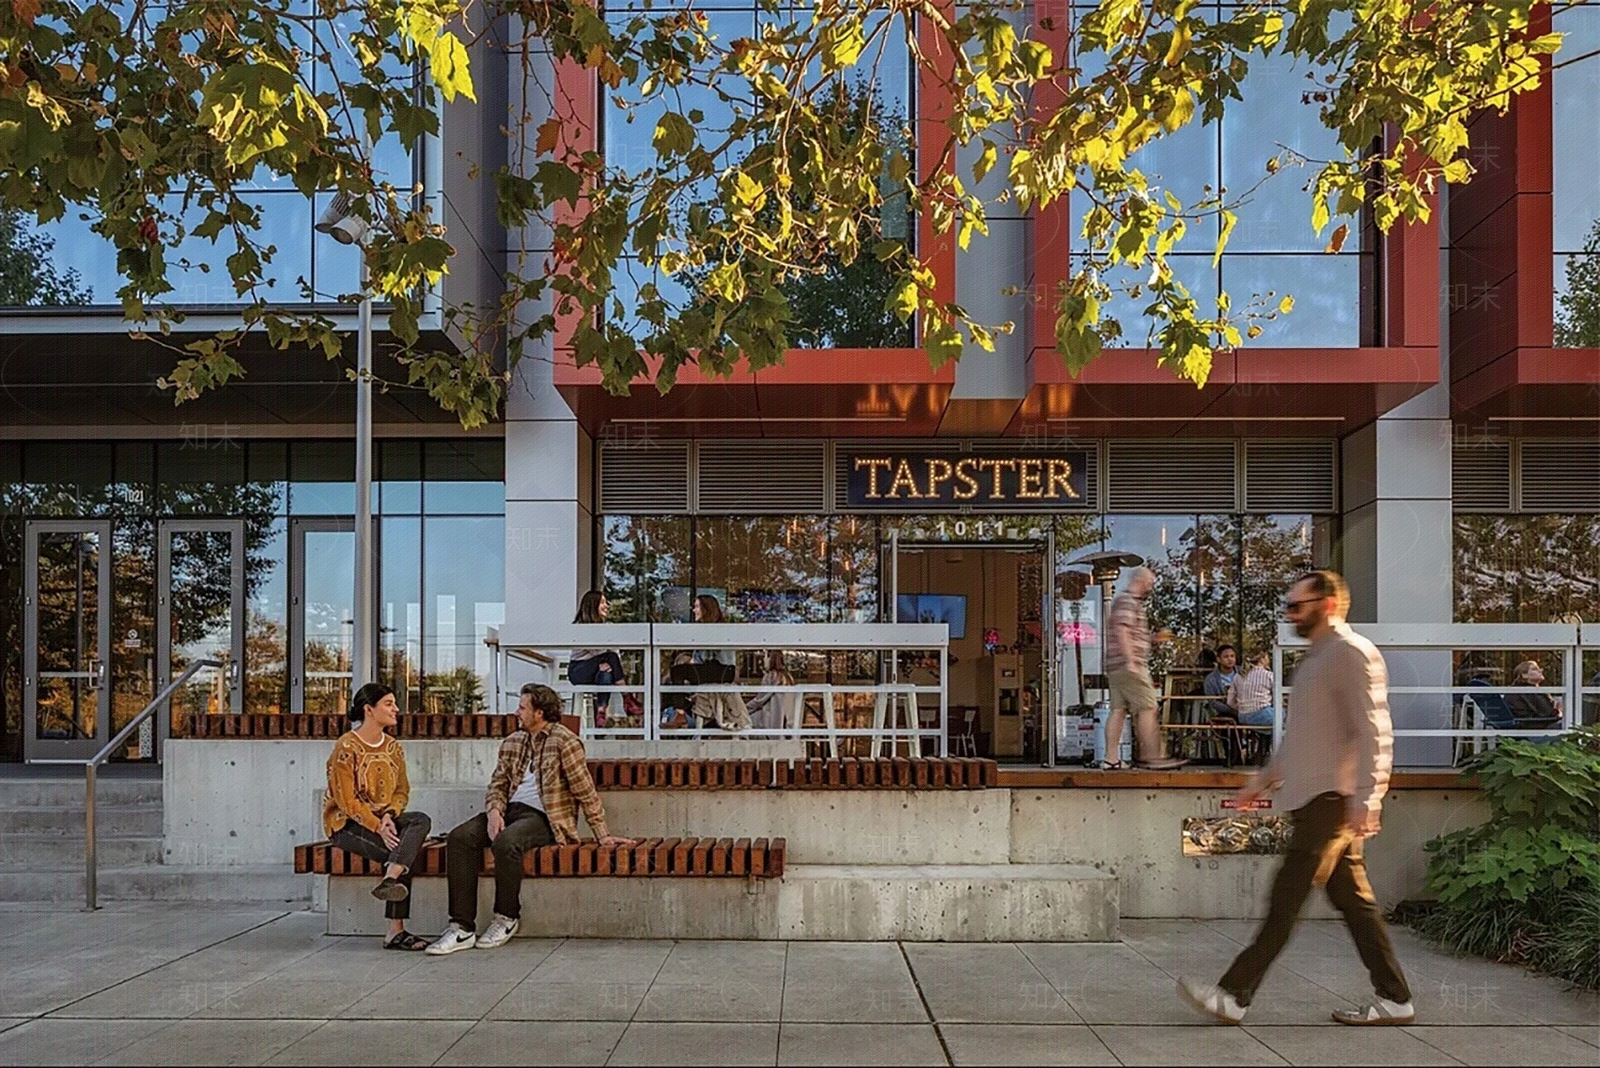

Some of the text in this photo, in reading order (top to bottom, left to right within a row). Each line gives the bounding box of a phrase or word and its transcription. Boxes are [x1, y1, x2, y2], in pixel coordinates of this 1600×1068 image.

[855, 458, 1080, 499] TAPSTER
[124, 490, 144, 503] 1021
[936, 521, 1003, 536] 1011
